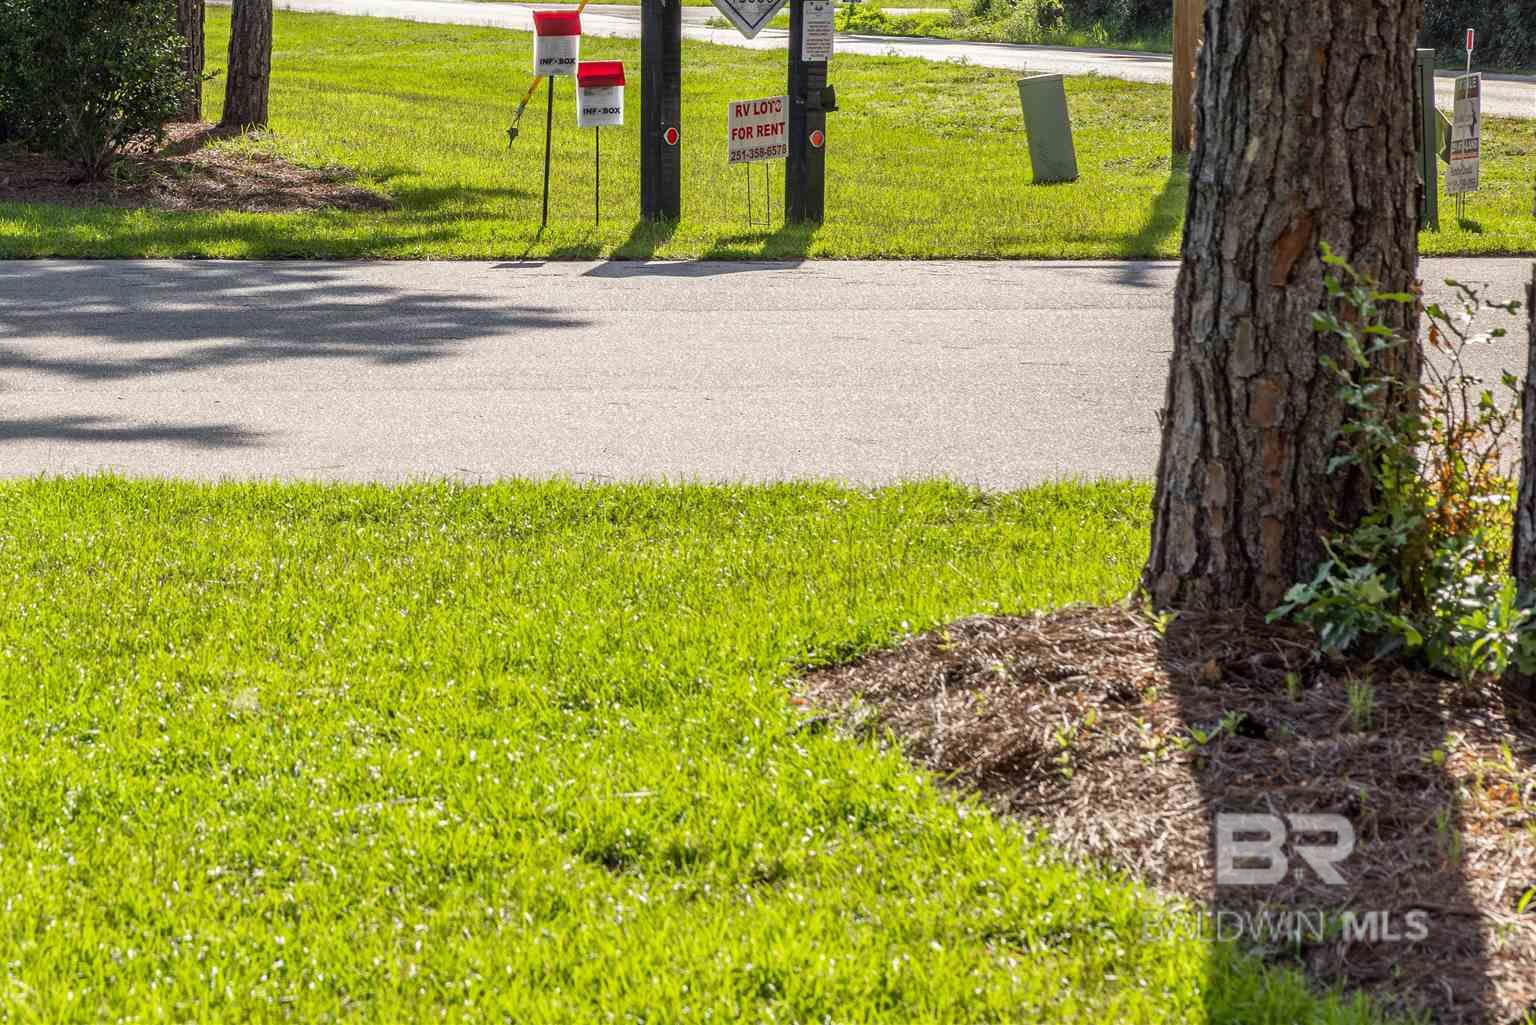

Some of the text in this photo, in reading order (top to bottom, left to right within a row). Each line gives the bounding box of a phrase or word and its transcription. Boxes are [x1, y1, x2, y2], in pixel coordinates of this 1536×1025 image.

[735, 103, 750, 118] RV
[731, 121, 785, 141] FOR RENT
